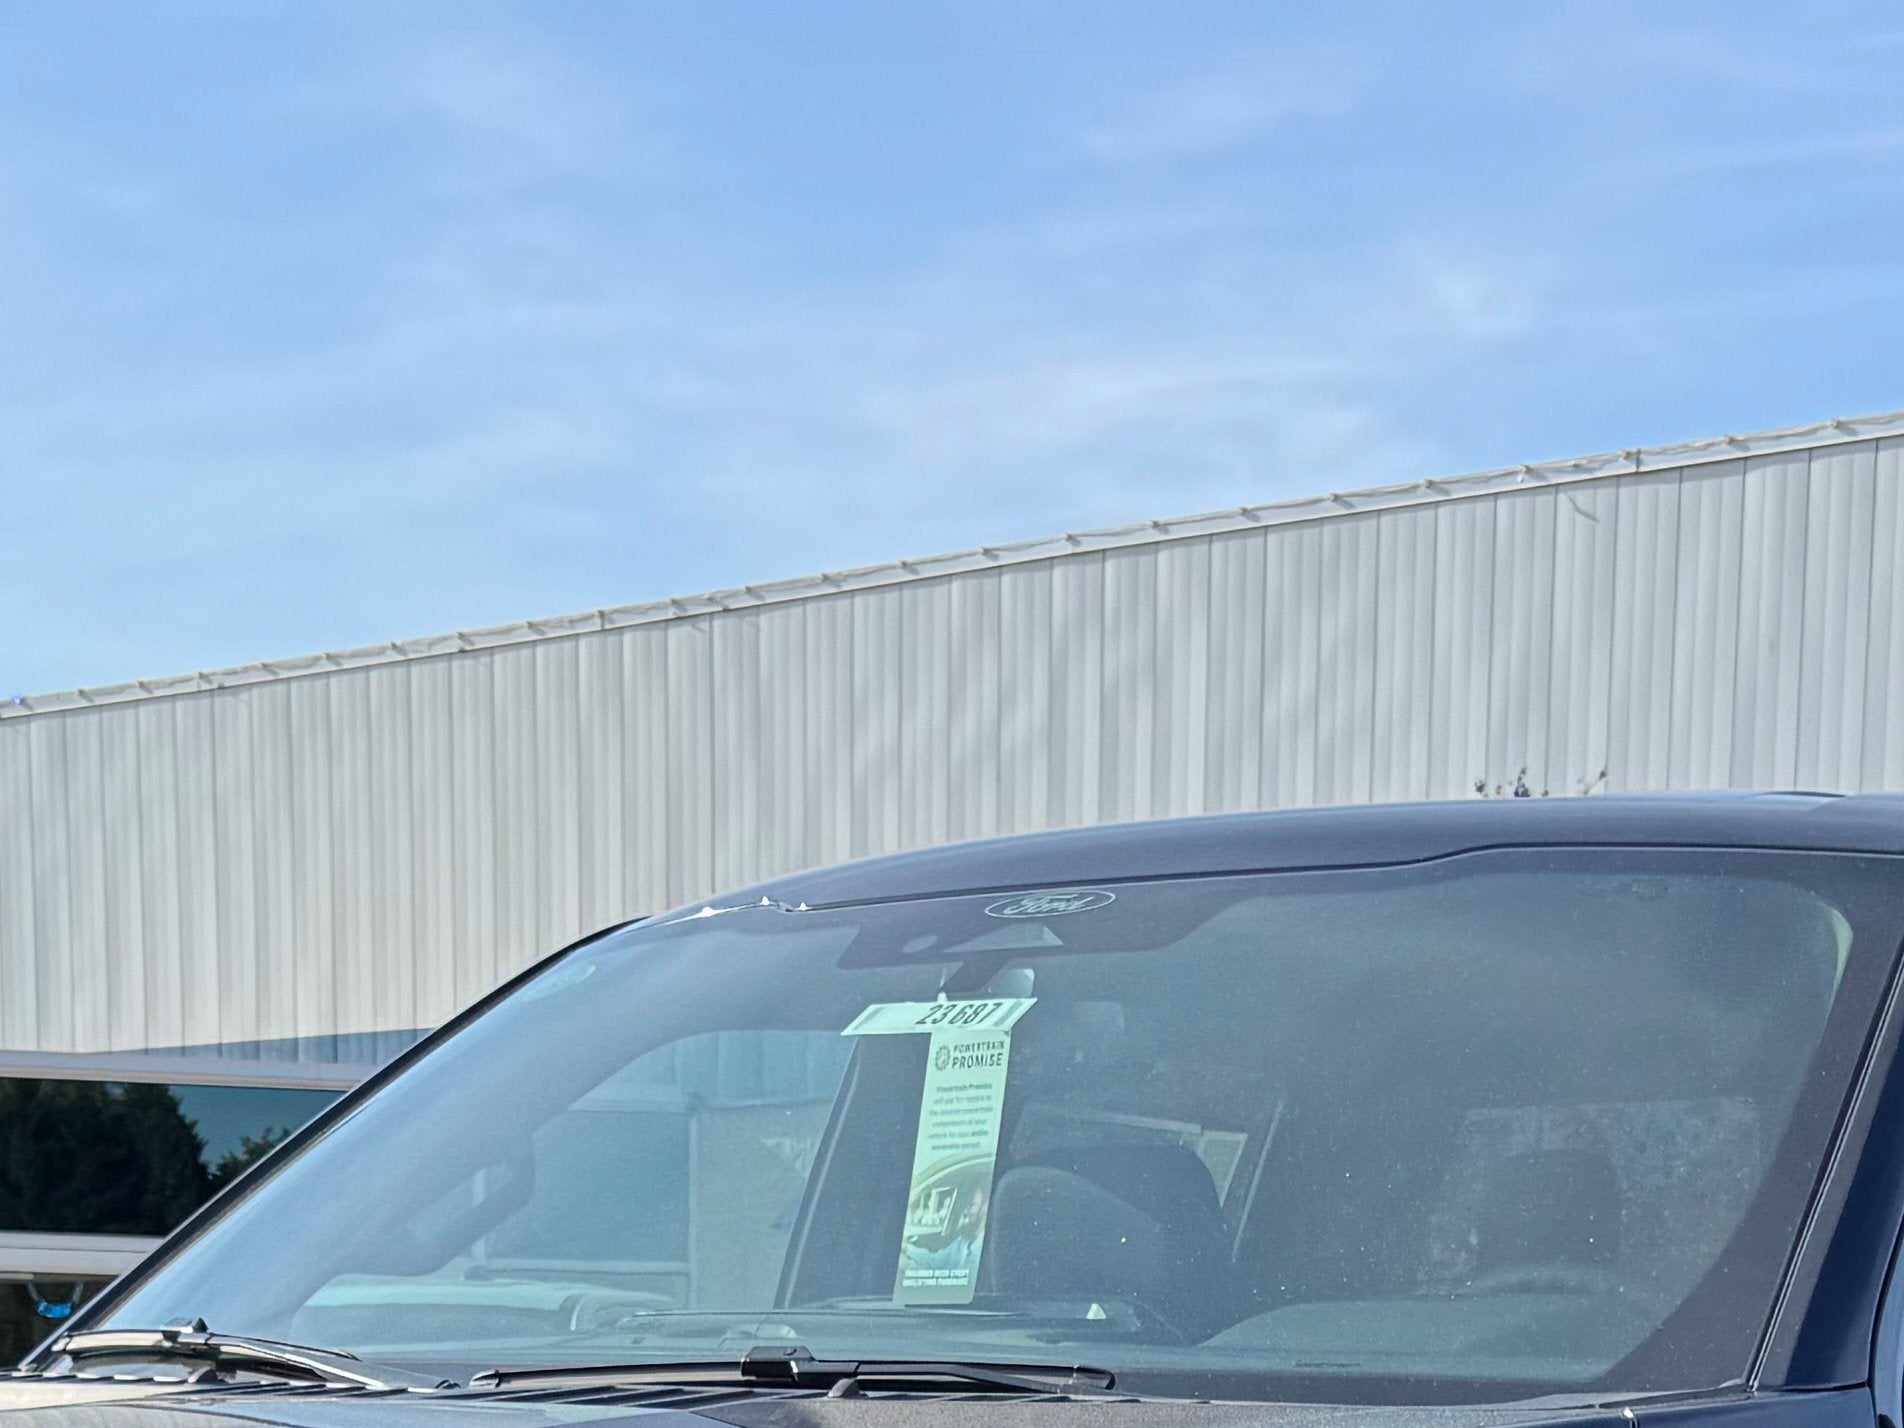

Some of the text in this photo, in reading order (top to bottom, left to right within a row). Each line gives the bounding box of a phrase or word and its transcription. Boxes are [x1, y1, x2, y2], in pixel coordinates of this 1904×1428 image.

[1002, 894, 1095, 915] Ford
[914, 1002, 1004, 1025] 23687
[951, 1053, 1004, 1069] PROMISE
